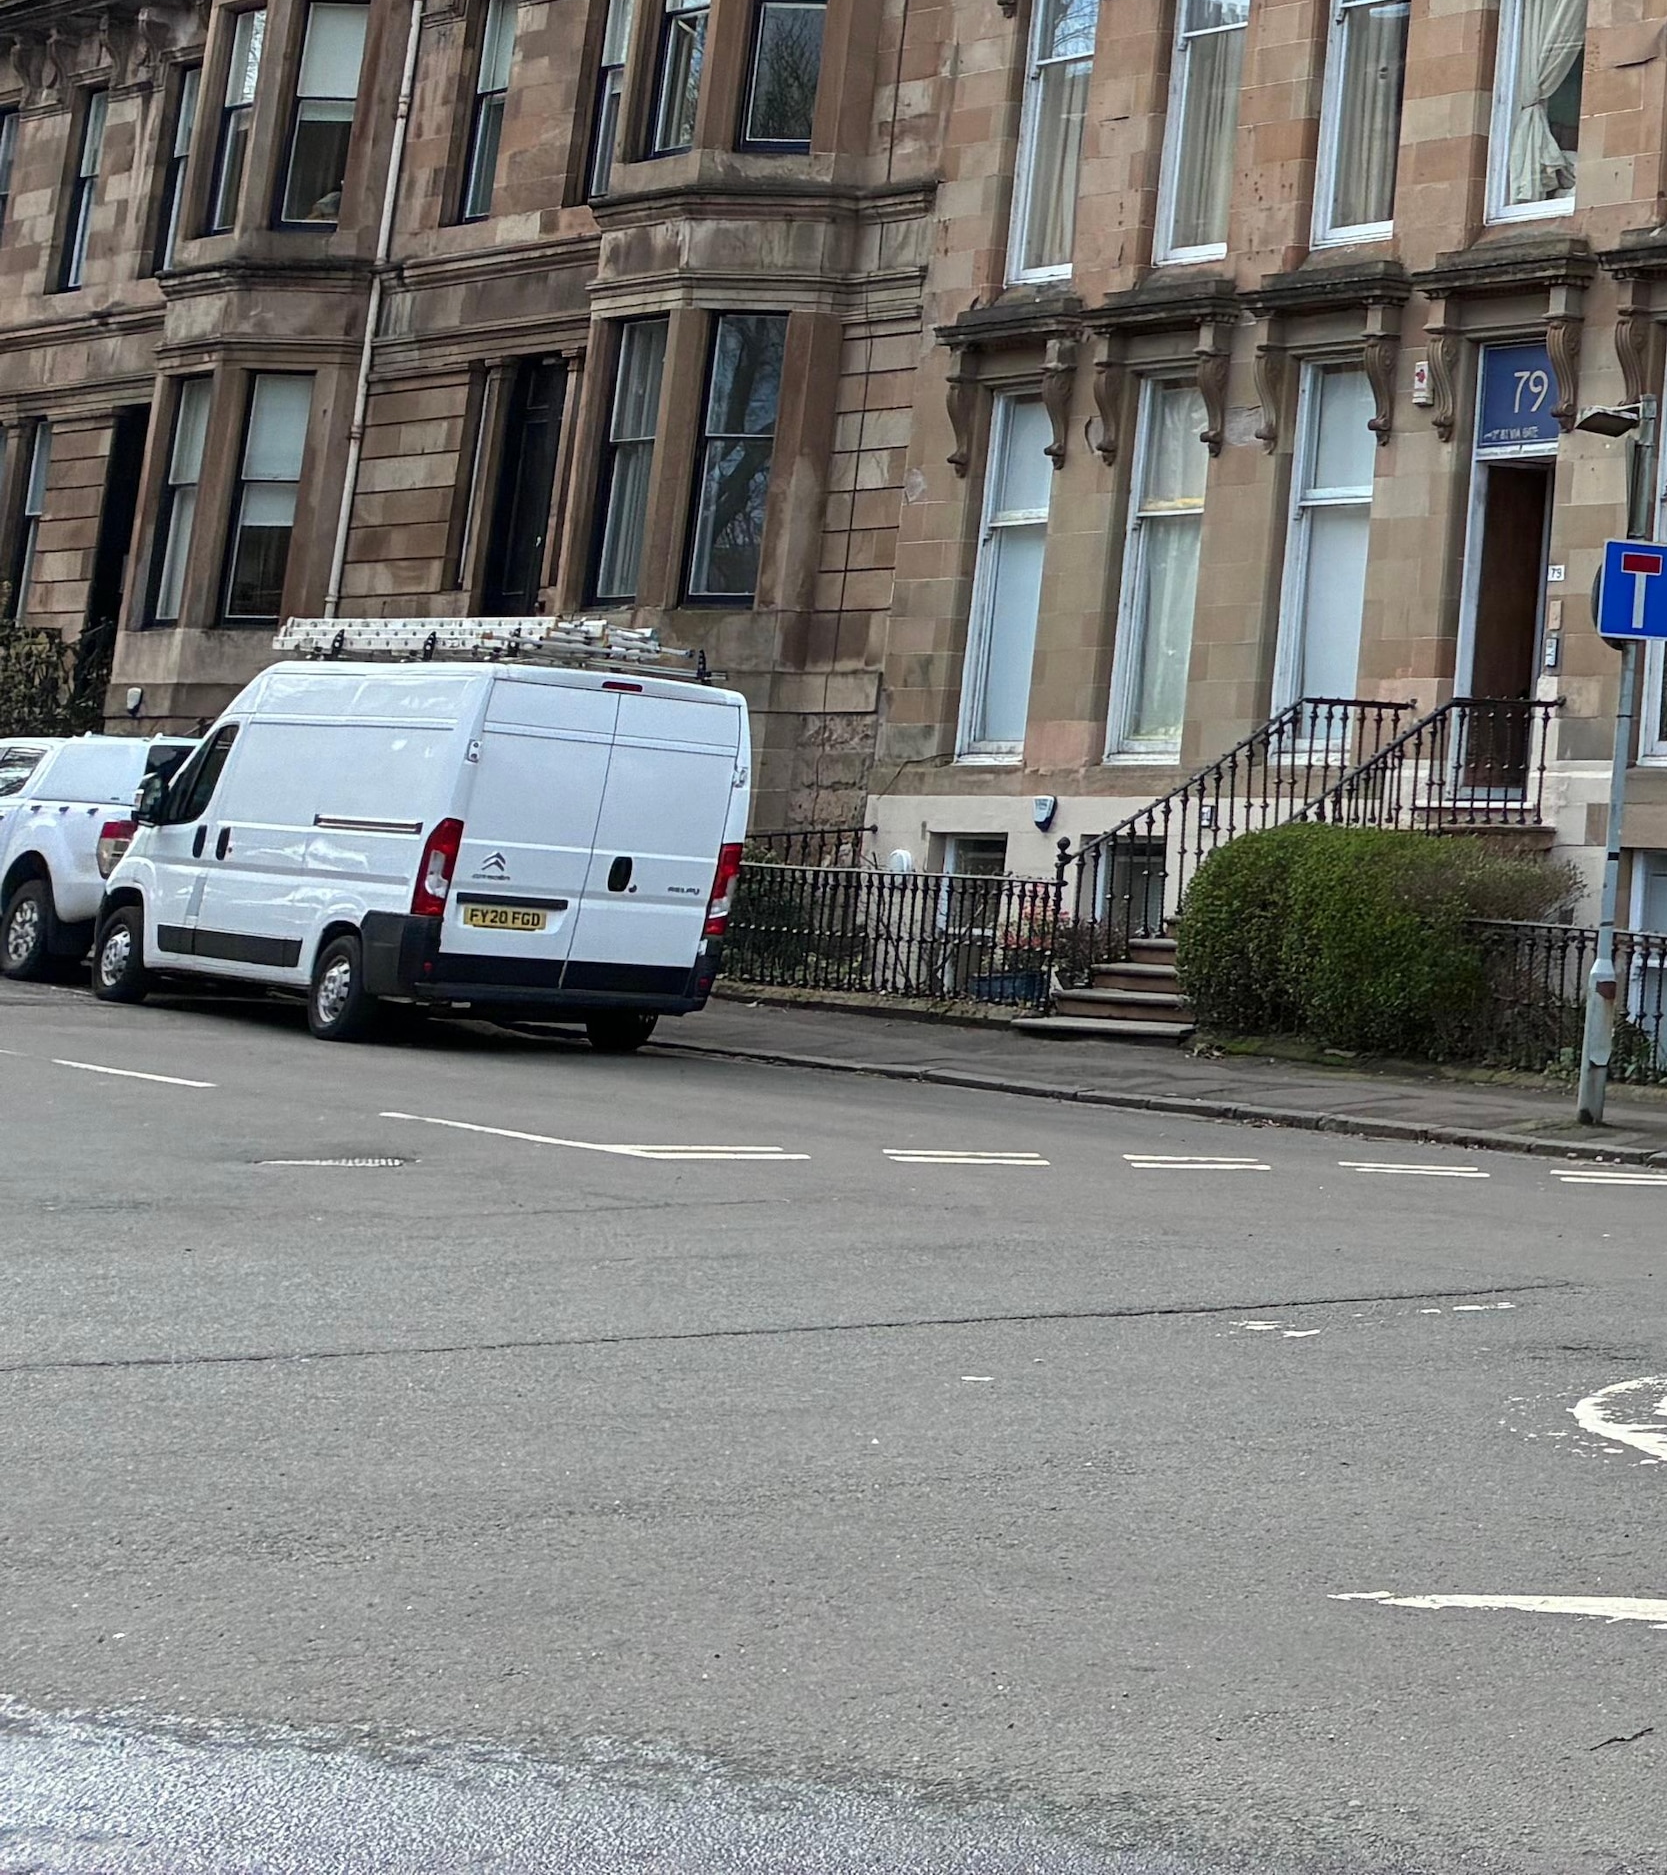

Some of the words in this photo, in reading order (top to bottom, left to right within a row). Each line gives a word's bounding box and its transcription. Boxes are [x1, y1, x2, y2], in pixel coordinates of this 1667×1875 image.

[1513, 370, 1549, 414] 79
[469, 908, 508, 924] FY20
[511, 911, 541, 927] FGD
